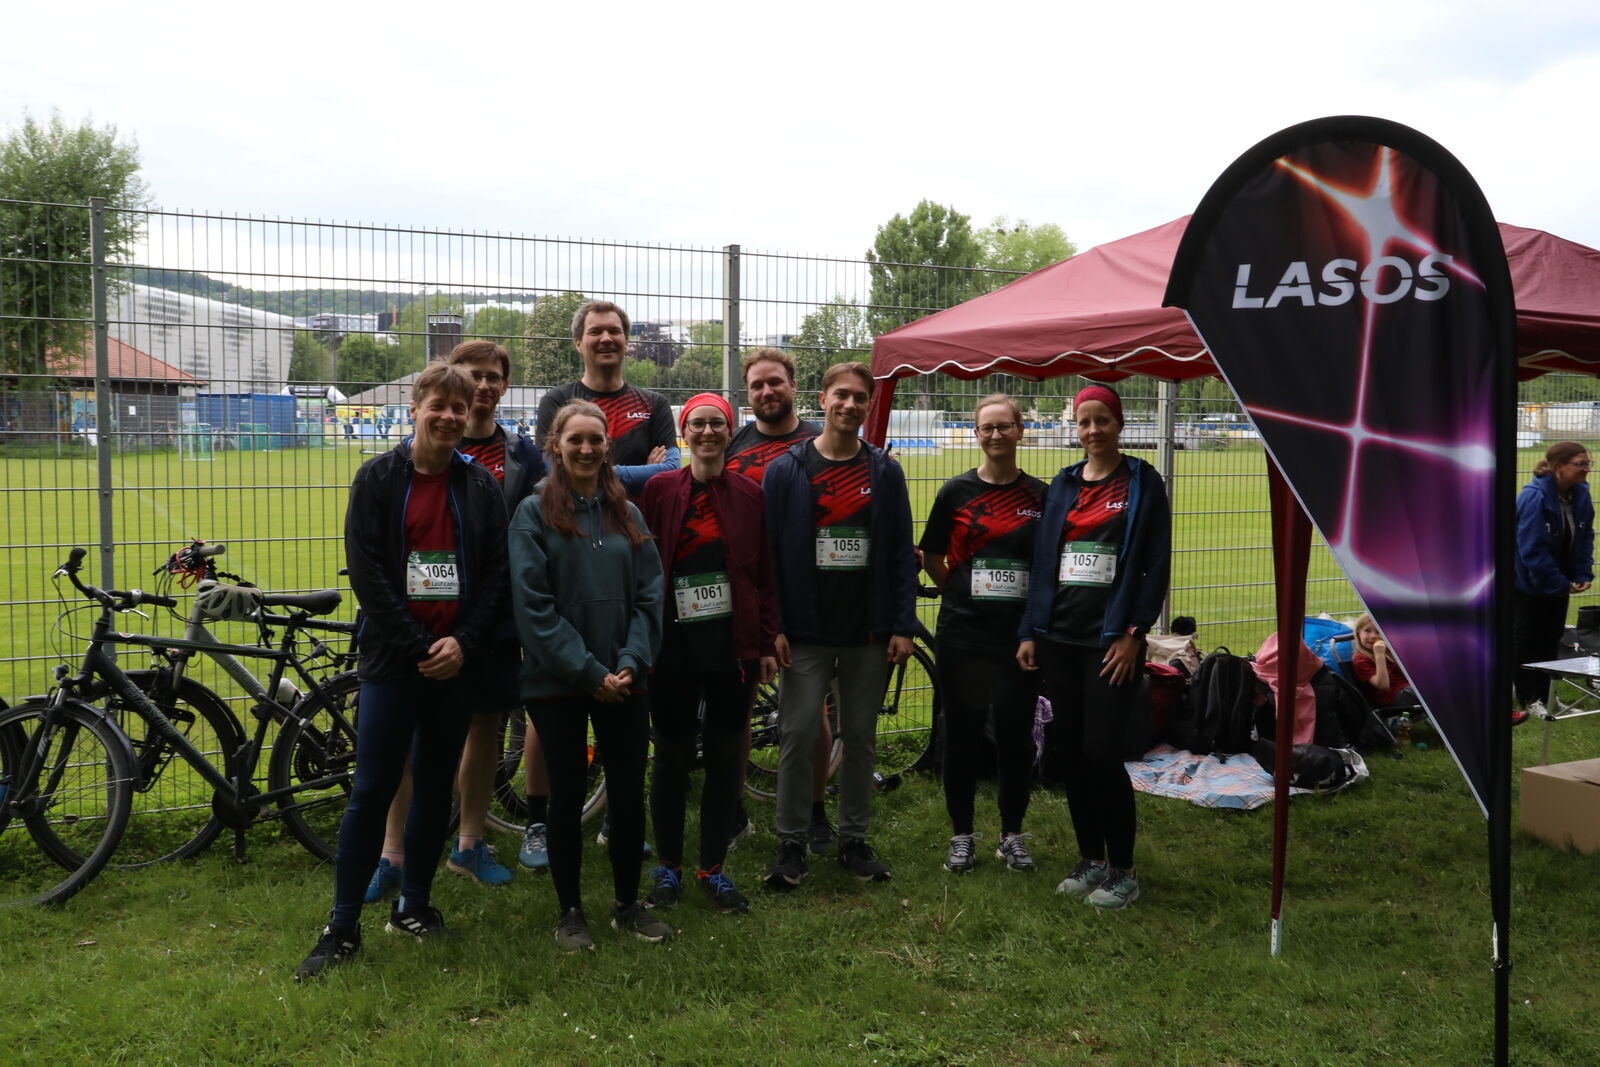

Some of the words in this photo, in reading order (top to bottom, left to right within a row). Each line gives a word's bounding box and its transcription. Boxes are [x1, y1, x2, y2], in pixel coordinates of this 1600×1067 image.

[1232, 253, 1453, 309] LASOS
[1016, 508, 1042, 519] LASOS
[833, 539, 860, 551] 1055
[1073, 553, 1099, 567] 1057
[425, 564, 454, 578] 1064
[988, 570, 1016, 583] 1056
[693, 585, 722, 600] 1061
